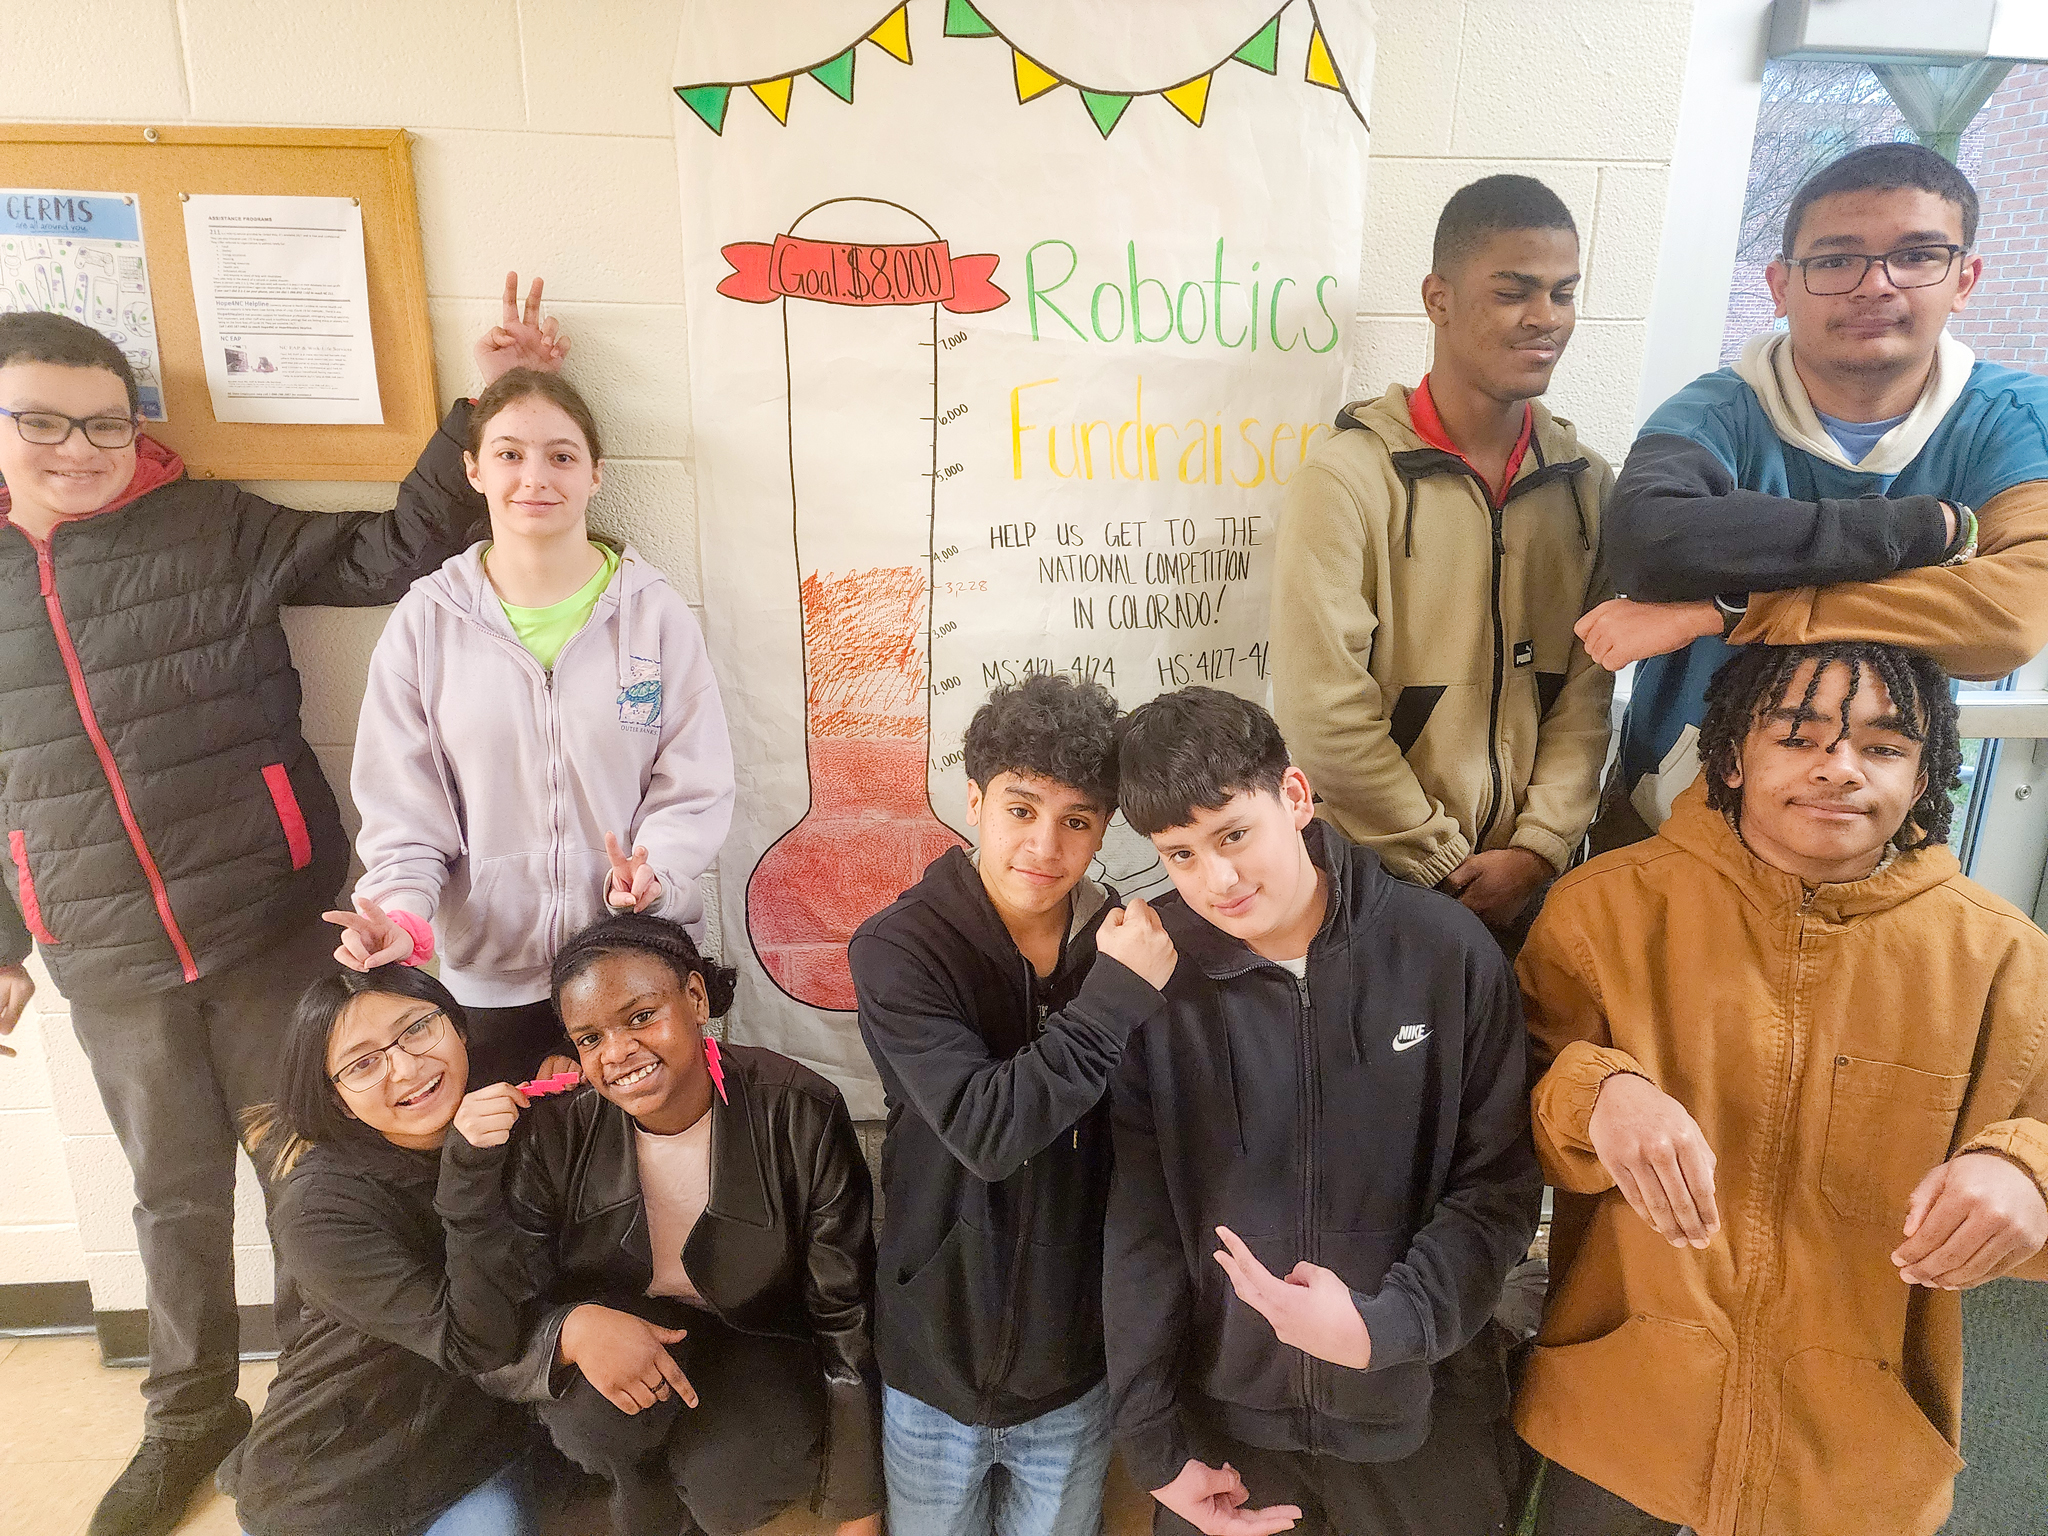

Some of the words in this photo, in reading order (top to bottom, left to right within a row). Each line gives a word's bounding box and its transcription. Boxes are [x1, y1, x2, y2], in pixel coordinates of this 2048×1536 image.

[6, 195, 93, 223] GERMS
[29, 219, 39, 229] all
[40, 222, 69, 231] around
[244, 300, 269, 308] Helpline
[1025, 236, 1339, 353] Robotics
[938, 331, 968, 351] 7,000
[938, 403, 969, 426] 6,000
[1010, 374, 1334, 489] Fundraiser
[935, 462, 964, 483] 5,000
[990, 521, 1036, 549] HELP
[1057, 522, 1084, 547] US
[1104, 521, 1147, 547] GET
[1164, 518, 1196, 546] TO
[1215, 515, 1262, 546] THE
[933, 545, 959, 564] 4,000
[1039, 553, 1137, 585] NATIONAL
[1146, 549, 1250, 585] COMPETITION
[946, 580, 988, 598] 3,228
[1073, 596, 1094, 629] IN
[1108, 584, 1227, 630] COLORADO!
[932, 620, 957, 640] 3,000
[931, 676, 961, 697] 2,000
[931, 749, 966, 773] 1,000
[1398, 1024, 1426, 1041] NIKE
